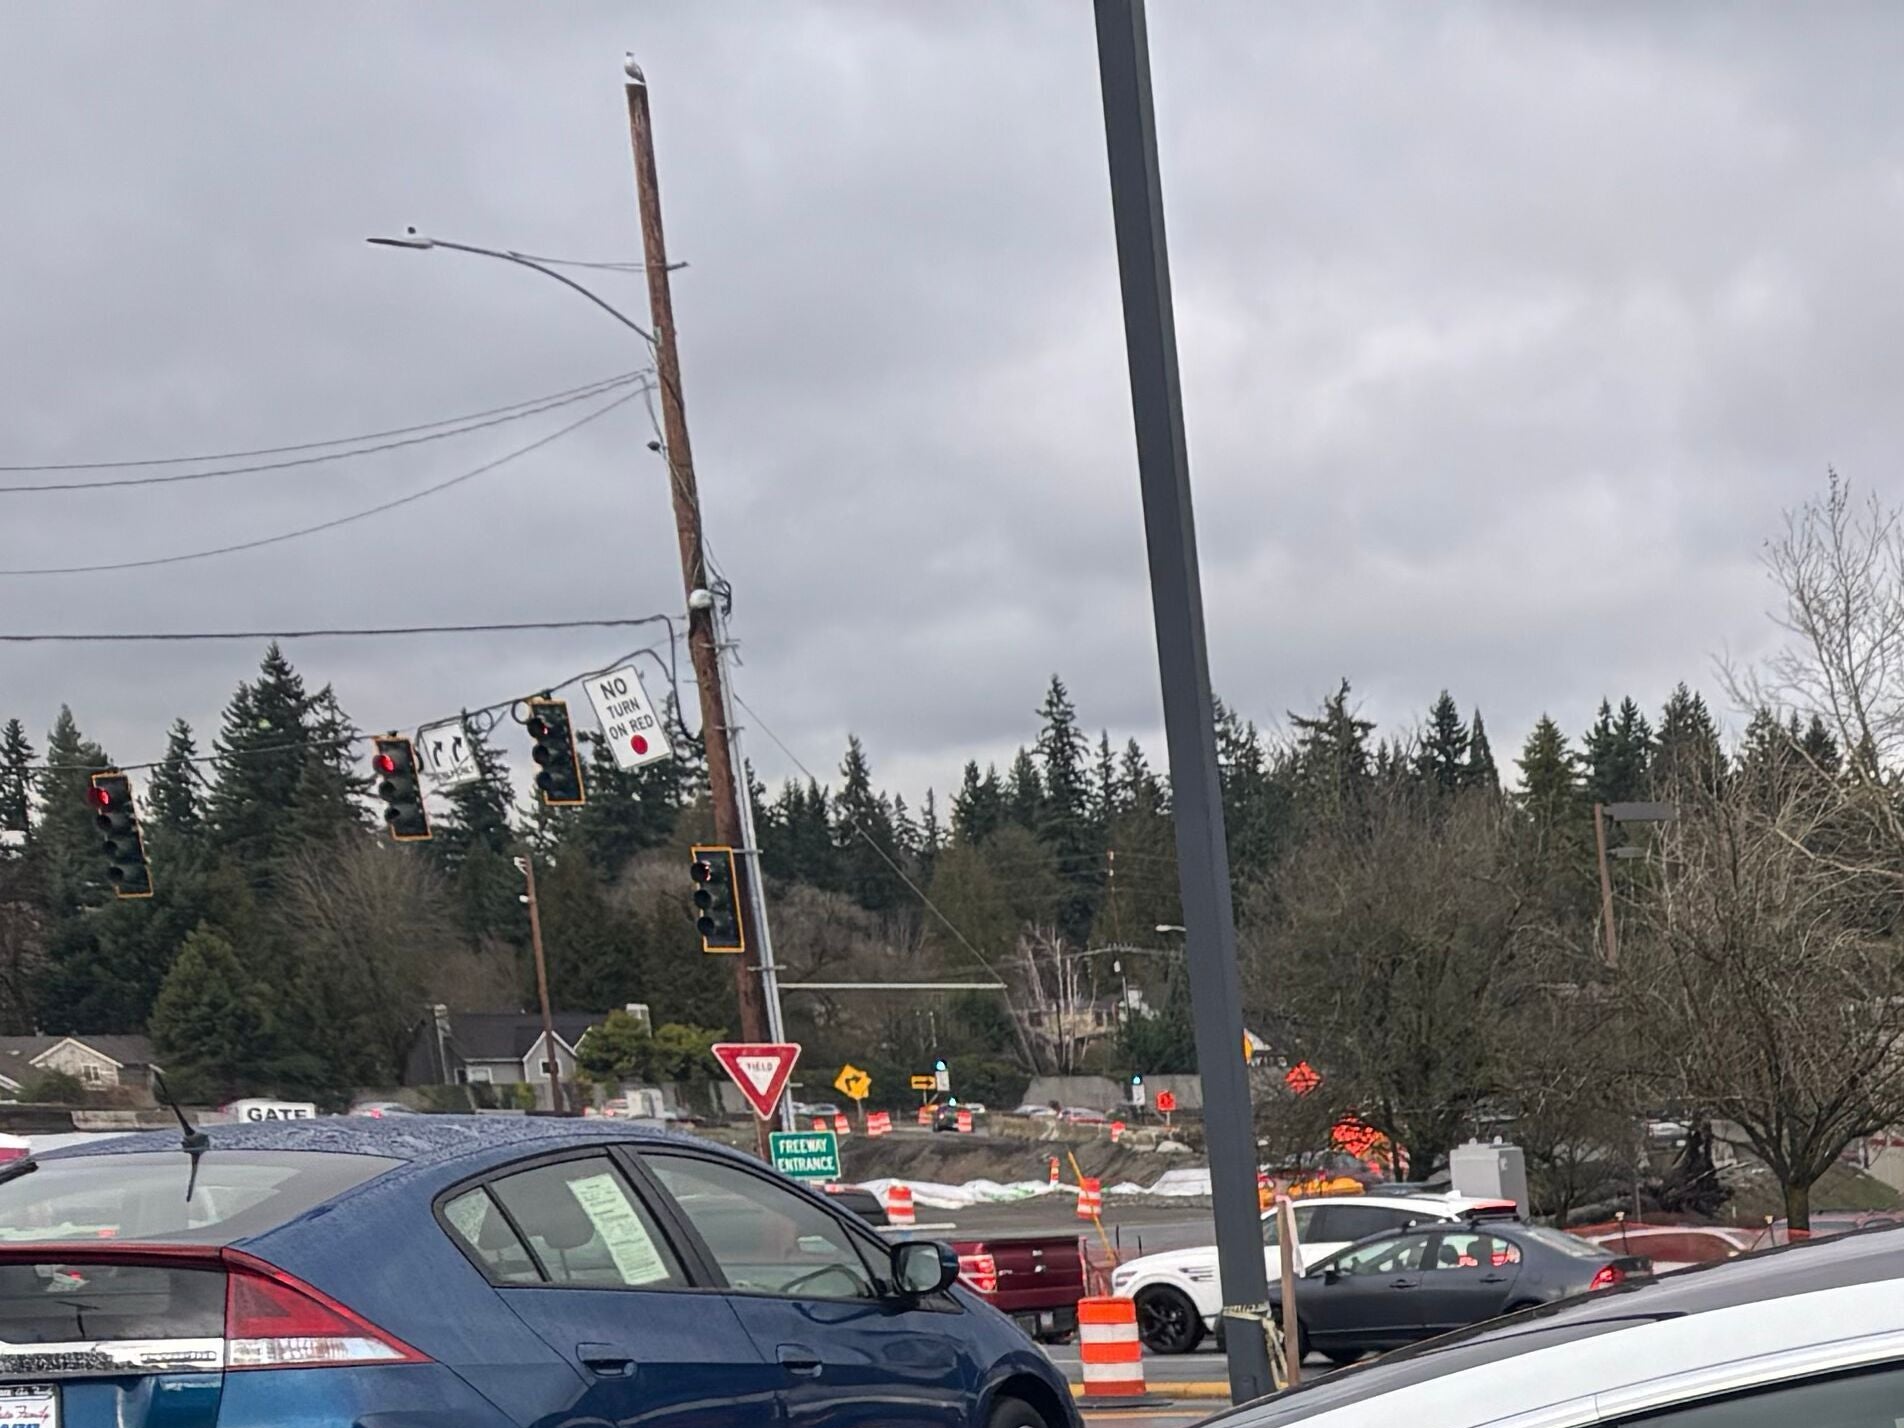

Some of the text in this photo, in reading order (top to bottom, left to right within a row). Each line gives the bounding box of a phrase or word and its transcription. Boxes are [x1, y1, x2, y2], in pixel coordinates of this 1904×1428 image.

[600, 677, 628, 700] NO
[606, 697, 641, 719] TURN
[609, 714, 655, 740] ON RED
[746, 1061, 774, 1072] YIELD
[247, 1107, 307, 1122] GATE
[779, 1137, 827, 1153] FREEWAY
[777, 1156, 835, 1172] ENTRANCE
